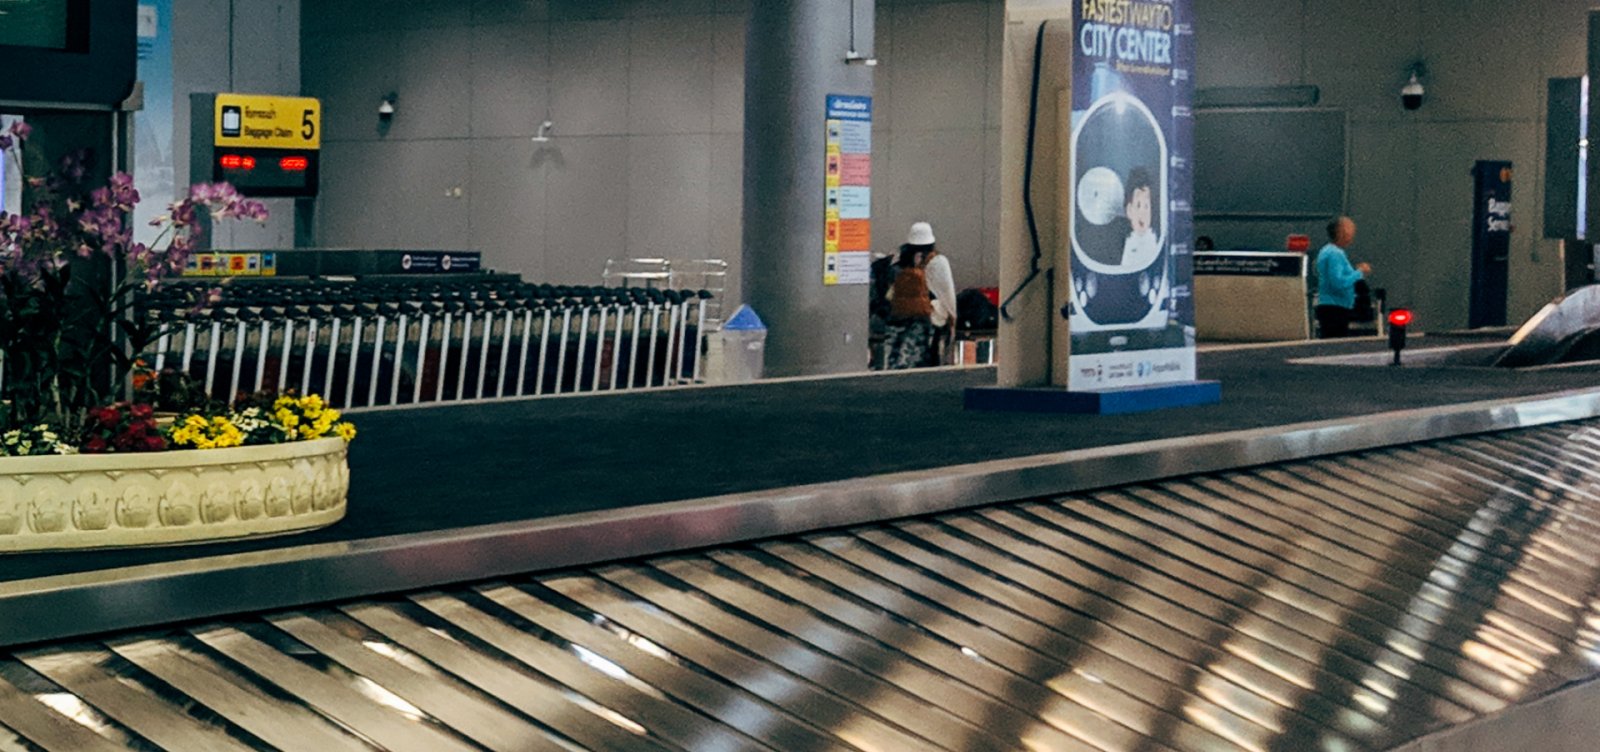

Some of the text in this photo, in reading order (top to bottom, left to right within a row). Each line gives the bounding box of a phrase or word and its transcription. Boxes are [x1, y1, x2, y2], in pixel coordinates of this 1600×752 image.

[1082, 0, 1129, 25] FASTEST
[1081, 22, 1172, 64] CITY CENTER
[301, 109, 315, 140] 5
